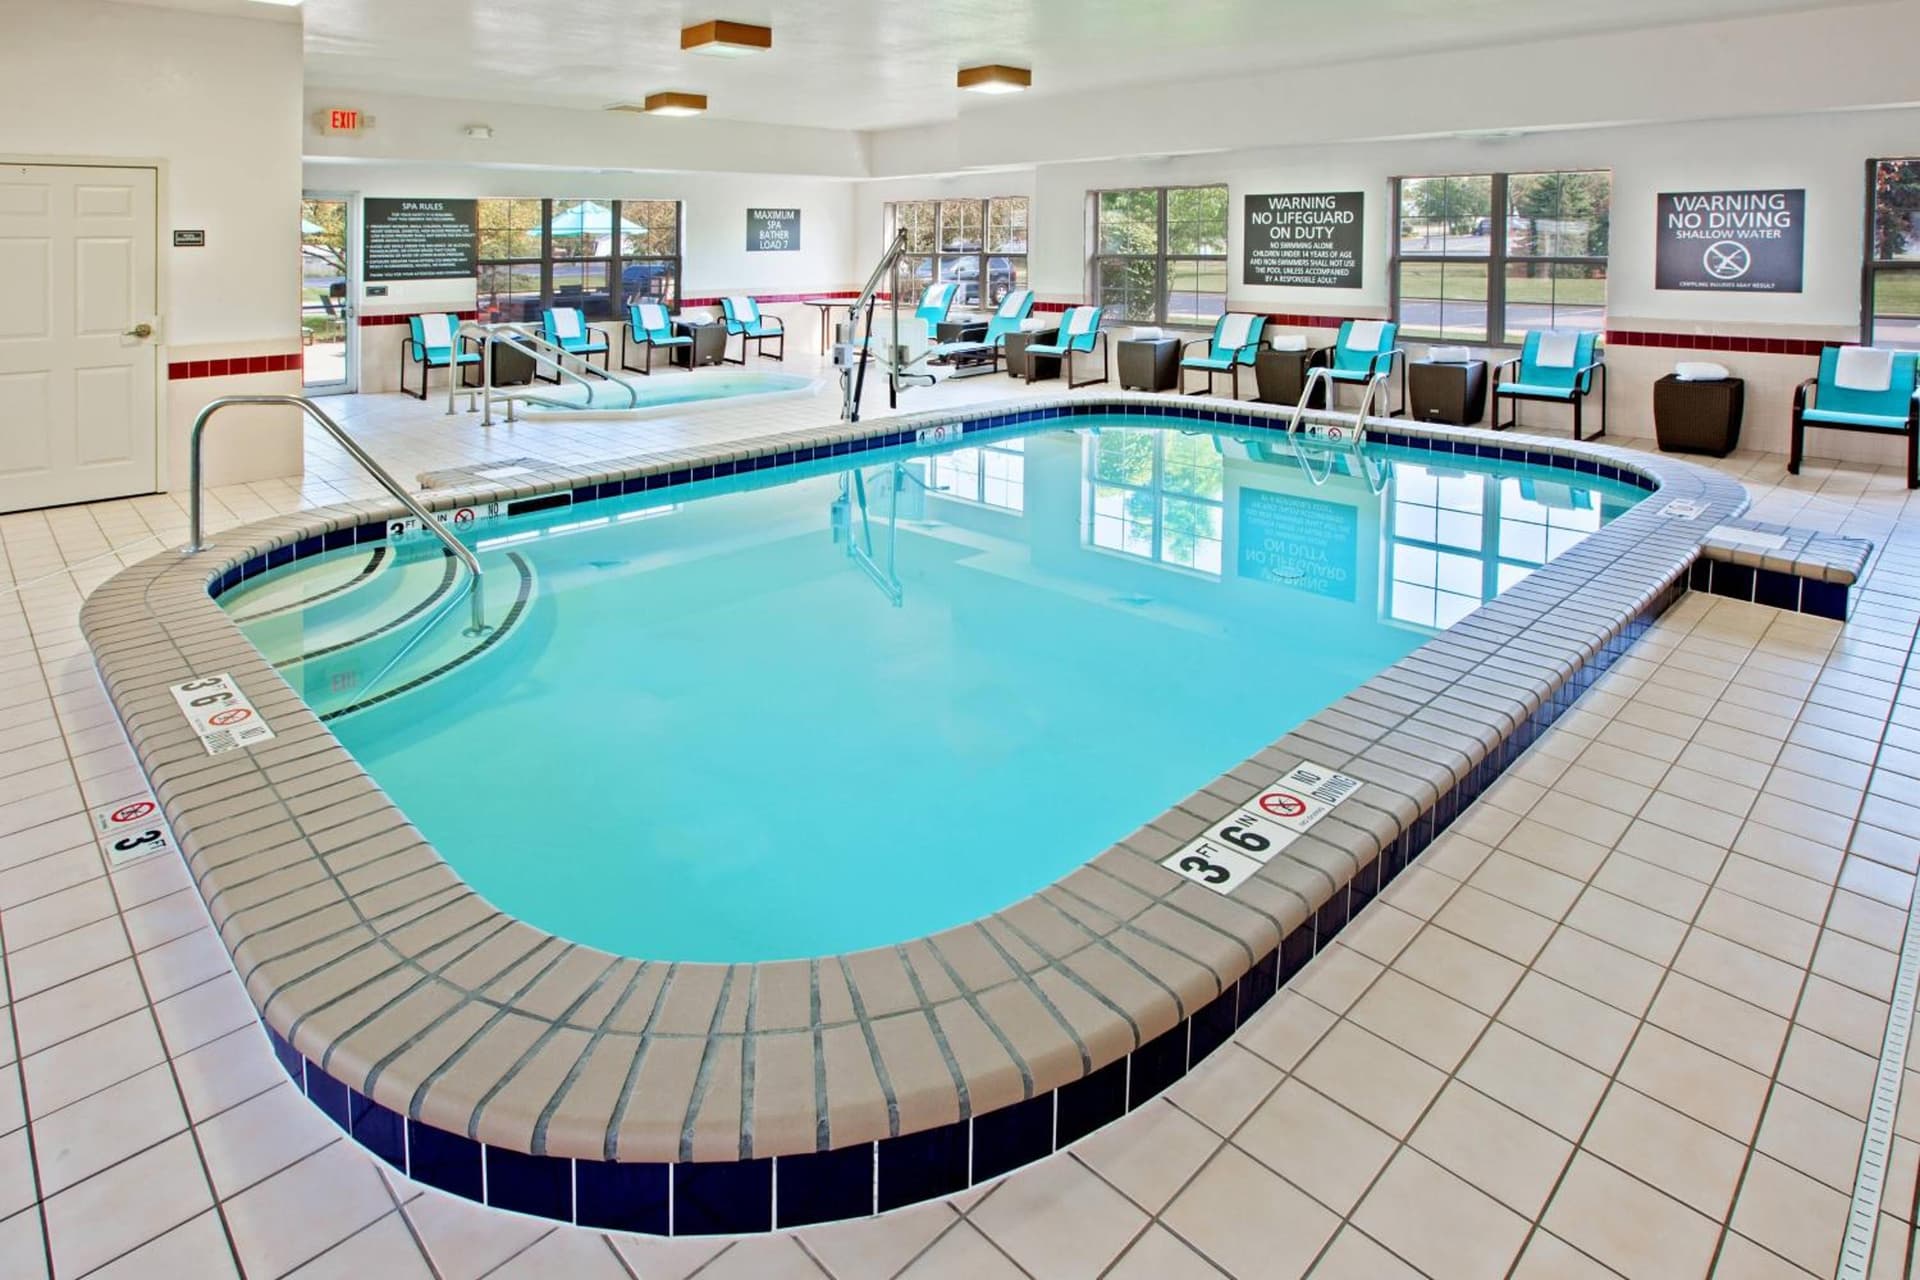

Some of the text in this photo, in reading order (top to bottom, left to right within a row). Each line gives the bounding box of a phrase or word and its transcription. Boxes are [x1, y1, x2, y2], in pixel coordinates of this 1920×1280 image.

[332, 111, 357, 129] EXIT
[1268, 196, 1336, 210] WARNING
[1672, 193, 1786, 212] WARNING
[754, 210, 795, 220] MAXIMUM
[1252, 211, 1354, 225] NO LIFEGUARD
[1668, 211, 1791, 229] NO DIVING
[767, 220, 781, 230] SPA
[760, 230, 789, 240] BATHER
[1270, 226, 1335, 239] ON DUTY
[1676, 229, 1782, 239] SHALLOW WATER
[760, 240, 789, 250] LOAD 7
[1310, 250, 1329, 258] YEARS
[1310, 259, 1328, 267] SHALL
[1329, 259, 1343, 267] NOT
[1344, 259, 1356, 267] USE
[1283, 267, 1304, 275] UNLESS
[1305, 268, 1350, 276] ACCOMPANIED
[1280, 275, 1316, 284] RESPONSIBLE
[1317, 276, 1338, 284] ADULT
[488, 503, 499, 515] NO
[405, 520, 415, 528] FT
[437, 514, 448, 522] IN
[181, 677, 222, 691] 3
[190, 692, 233, 707] 6
[1290, 769, 1322, 786] NO
[1311, 774, 1358, 803] DIVING
[1219, 814, 1271, 852] 6 IN
[114, 830, 162, 851] 3
[1179, 842, 1231, 884] 3 FT
